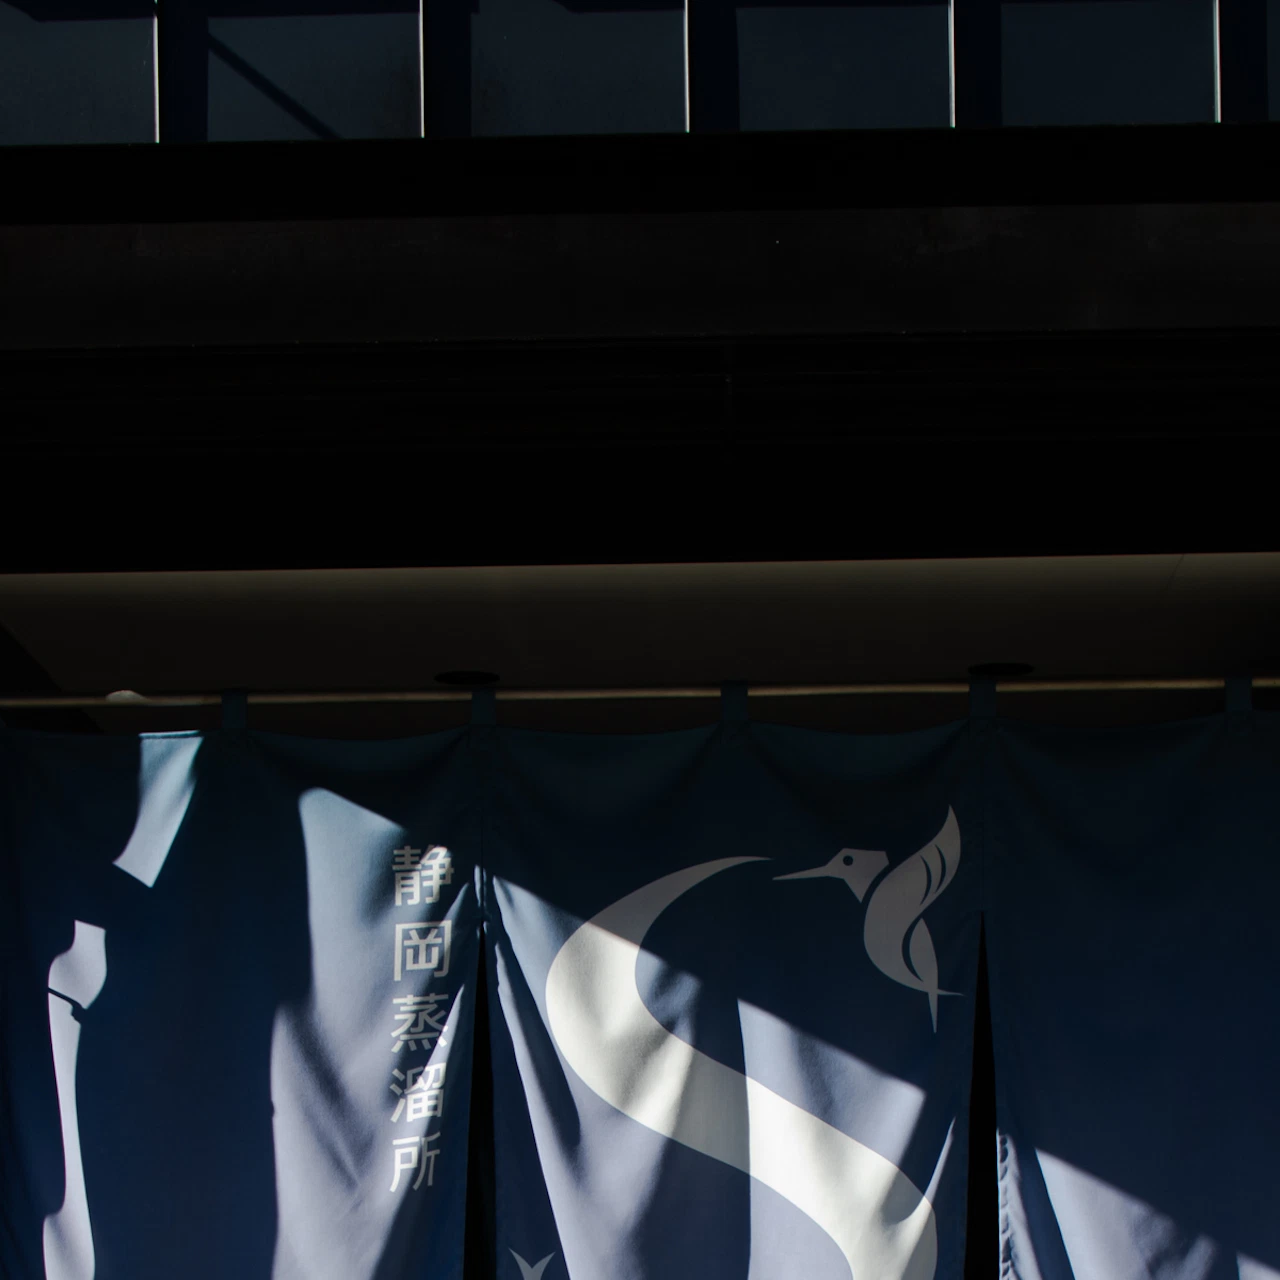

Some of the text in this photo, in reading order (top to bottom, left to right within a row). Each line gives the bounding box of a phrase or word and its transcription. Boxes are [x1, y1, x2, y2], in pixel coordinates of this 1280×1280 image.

[390, 844, 455, 1193] 静岡蒸溜所
